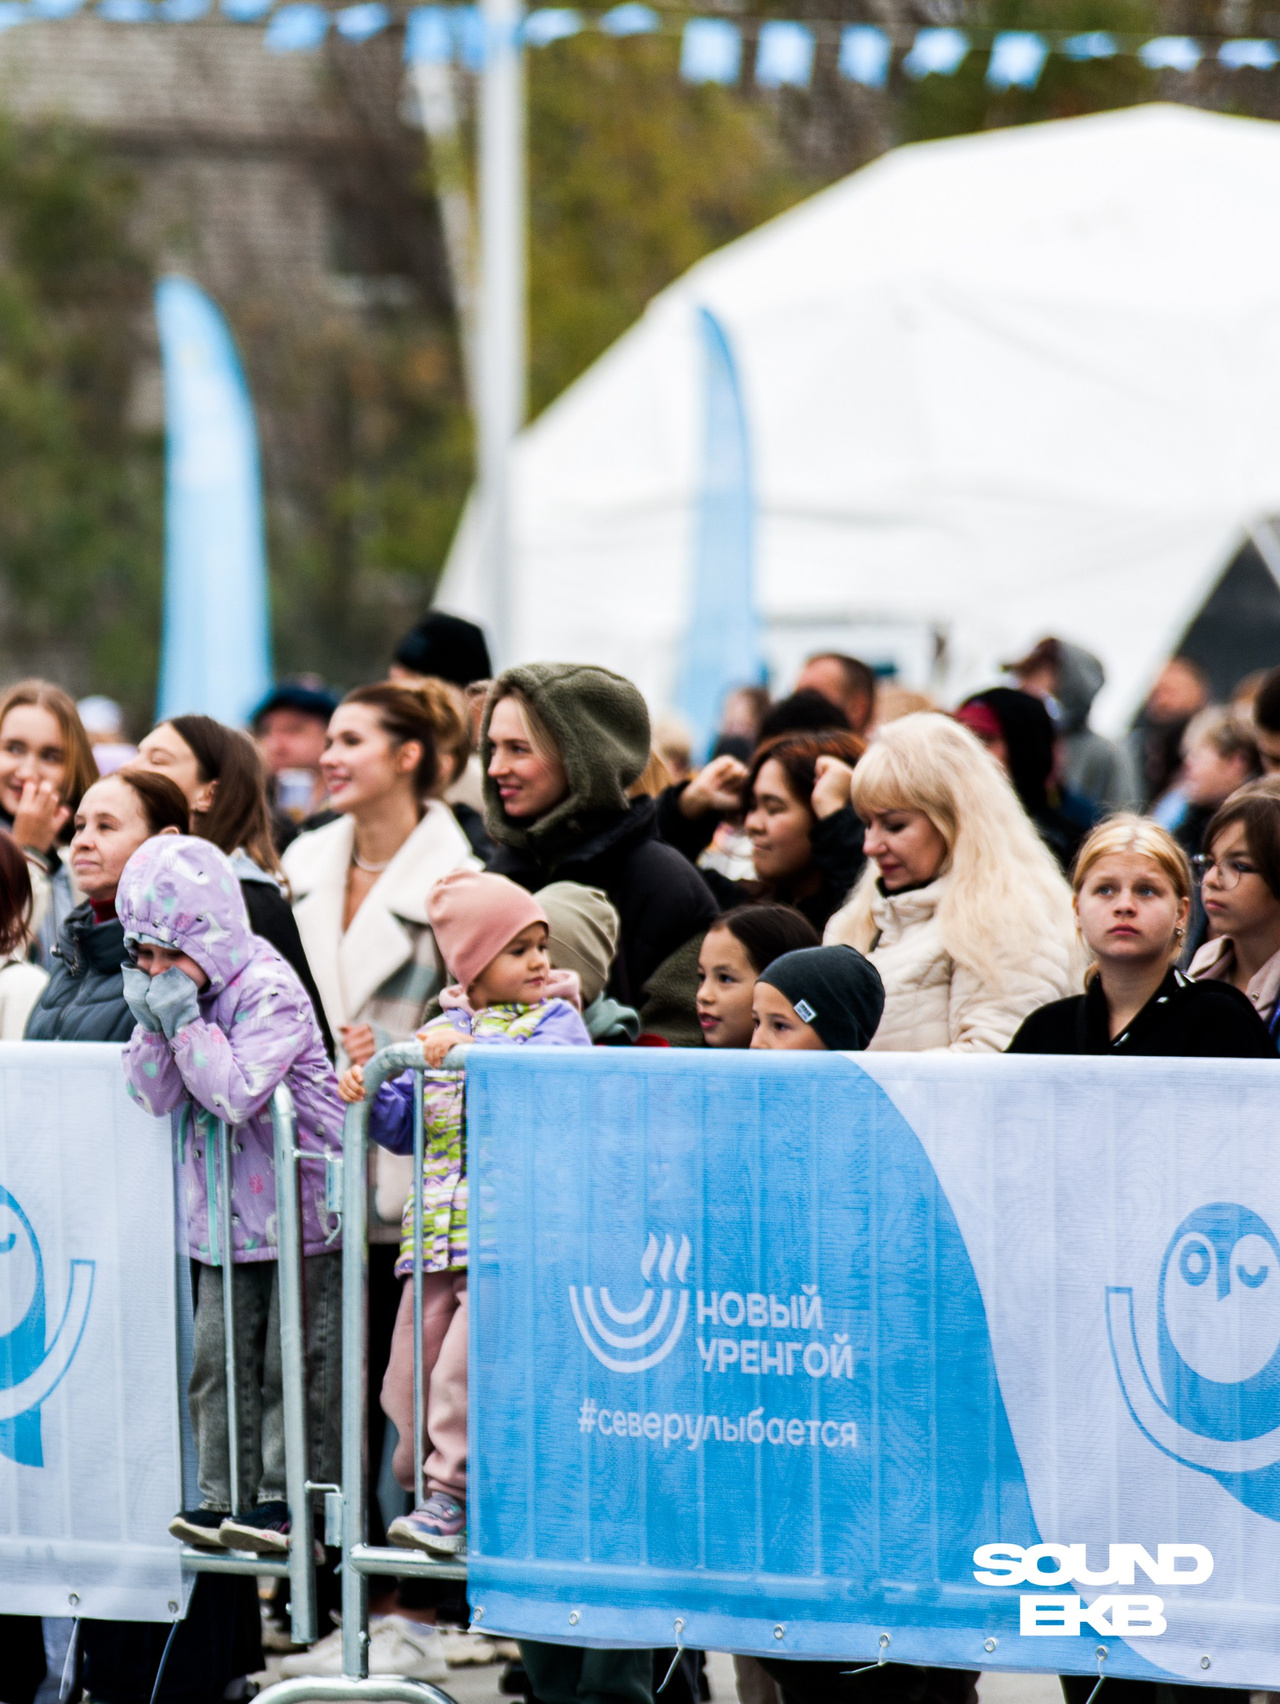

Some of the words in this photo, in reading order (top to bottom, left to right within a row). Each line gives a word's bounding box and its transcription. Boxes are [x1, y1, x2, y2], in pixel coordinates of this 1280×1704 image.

[695, 1283, 824, 1330] НОВЫЙ
[695, 1332, 854, 1380] УРЕНГОЙ
[577, 1397, 859, 1451] #северулыбается
